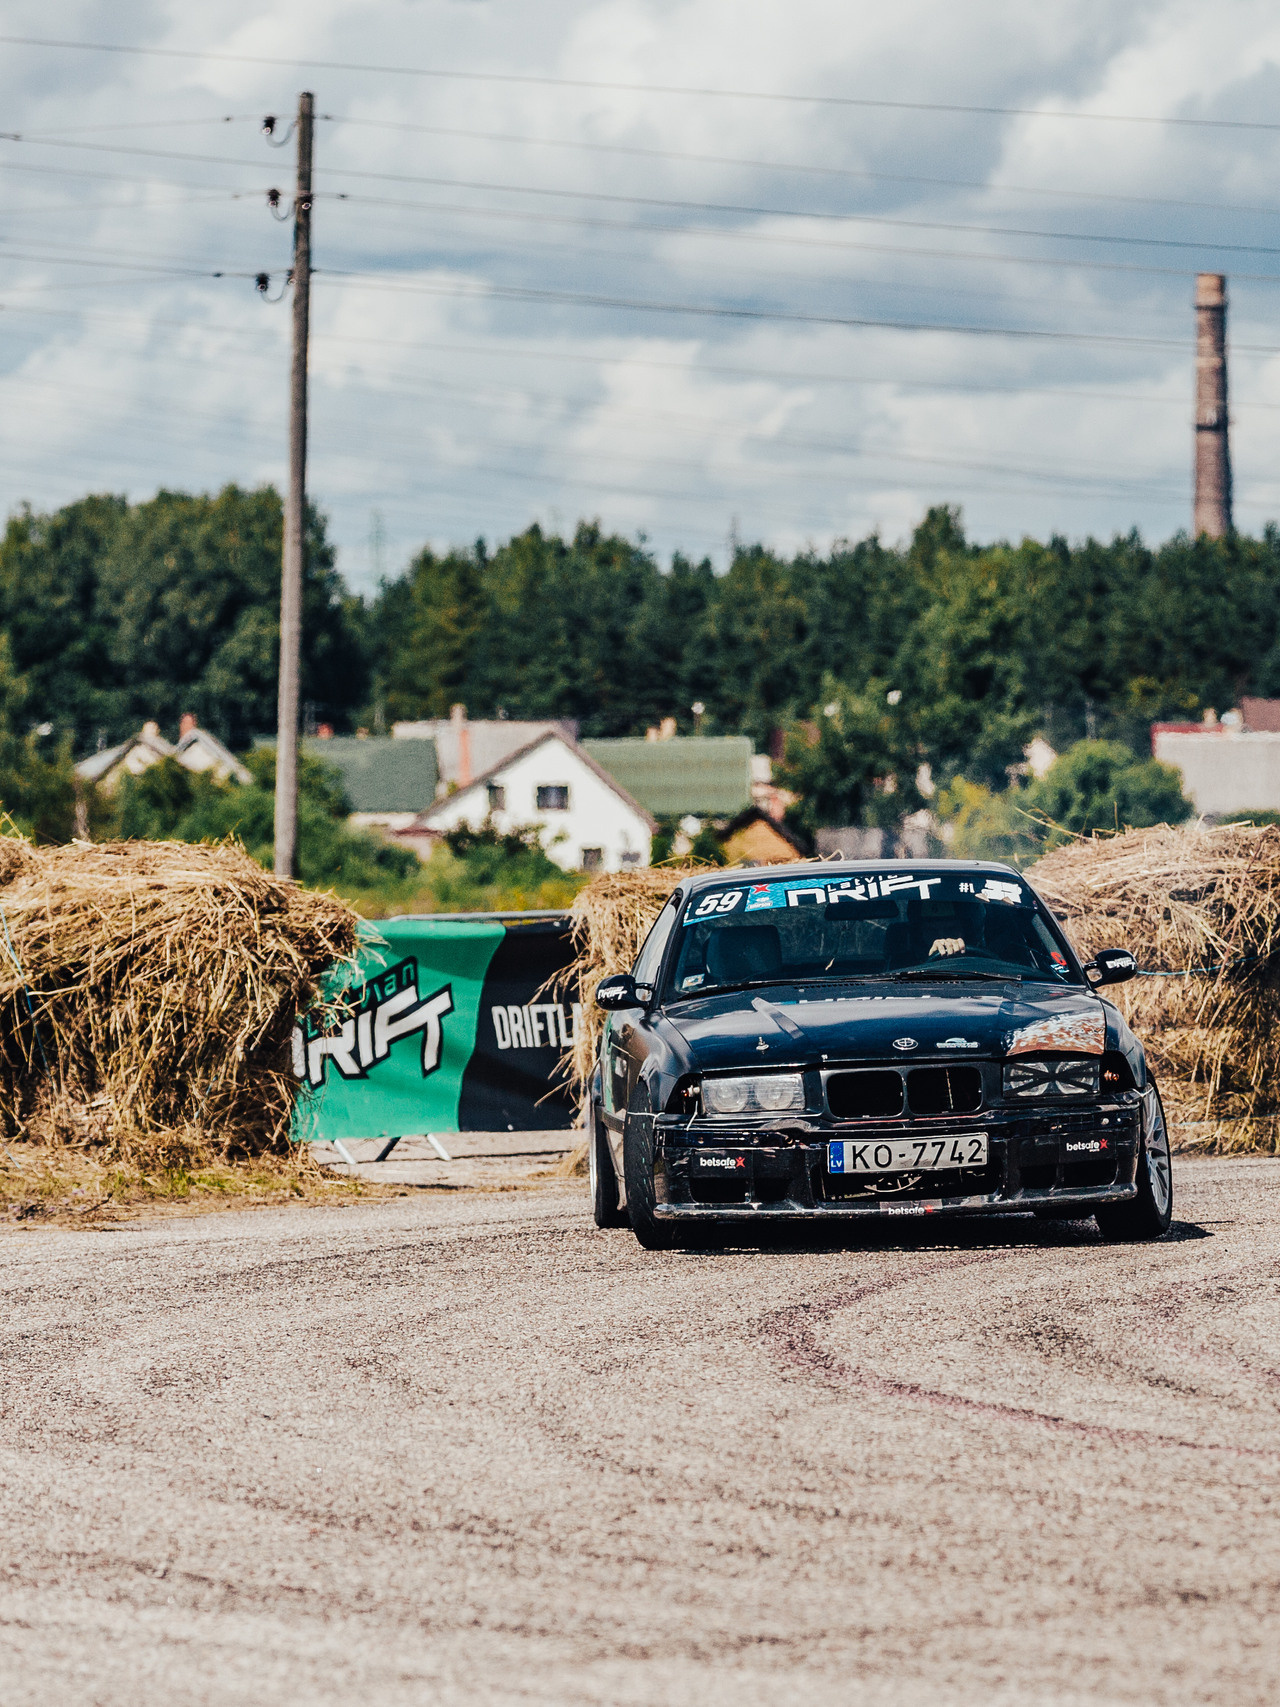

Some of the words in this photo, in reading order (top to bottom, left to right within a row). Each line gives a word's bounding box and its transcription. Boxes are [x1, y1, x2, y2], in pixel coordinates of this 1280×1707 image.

[788, 875, 941, 907] DRIFT
[695, 891, 743, 916] 59
[830, 1159, 843, 1168] LV
[852, 1139, 983, 1170] KO-7742
[1066, 1140, 1100, 1151] betsafe
[700, 1156, 736, 1167] betsafe
[888, 1206, 925, 1215] betsafe
